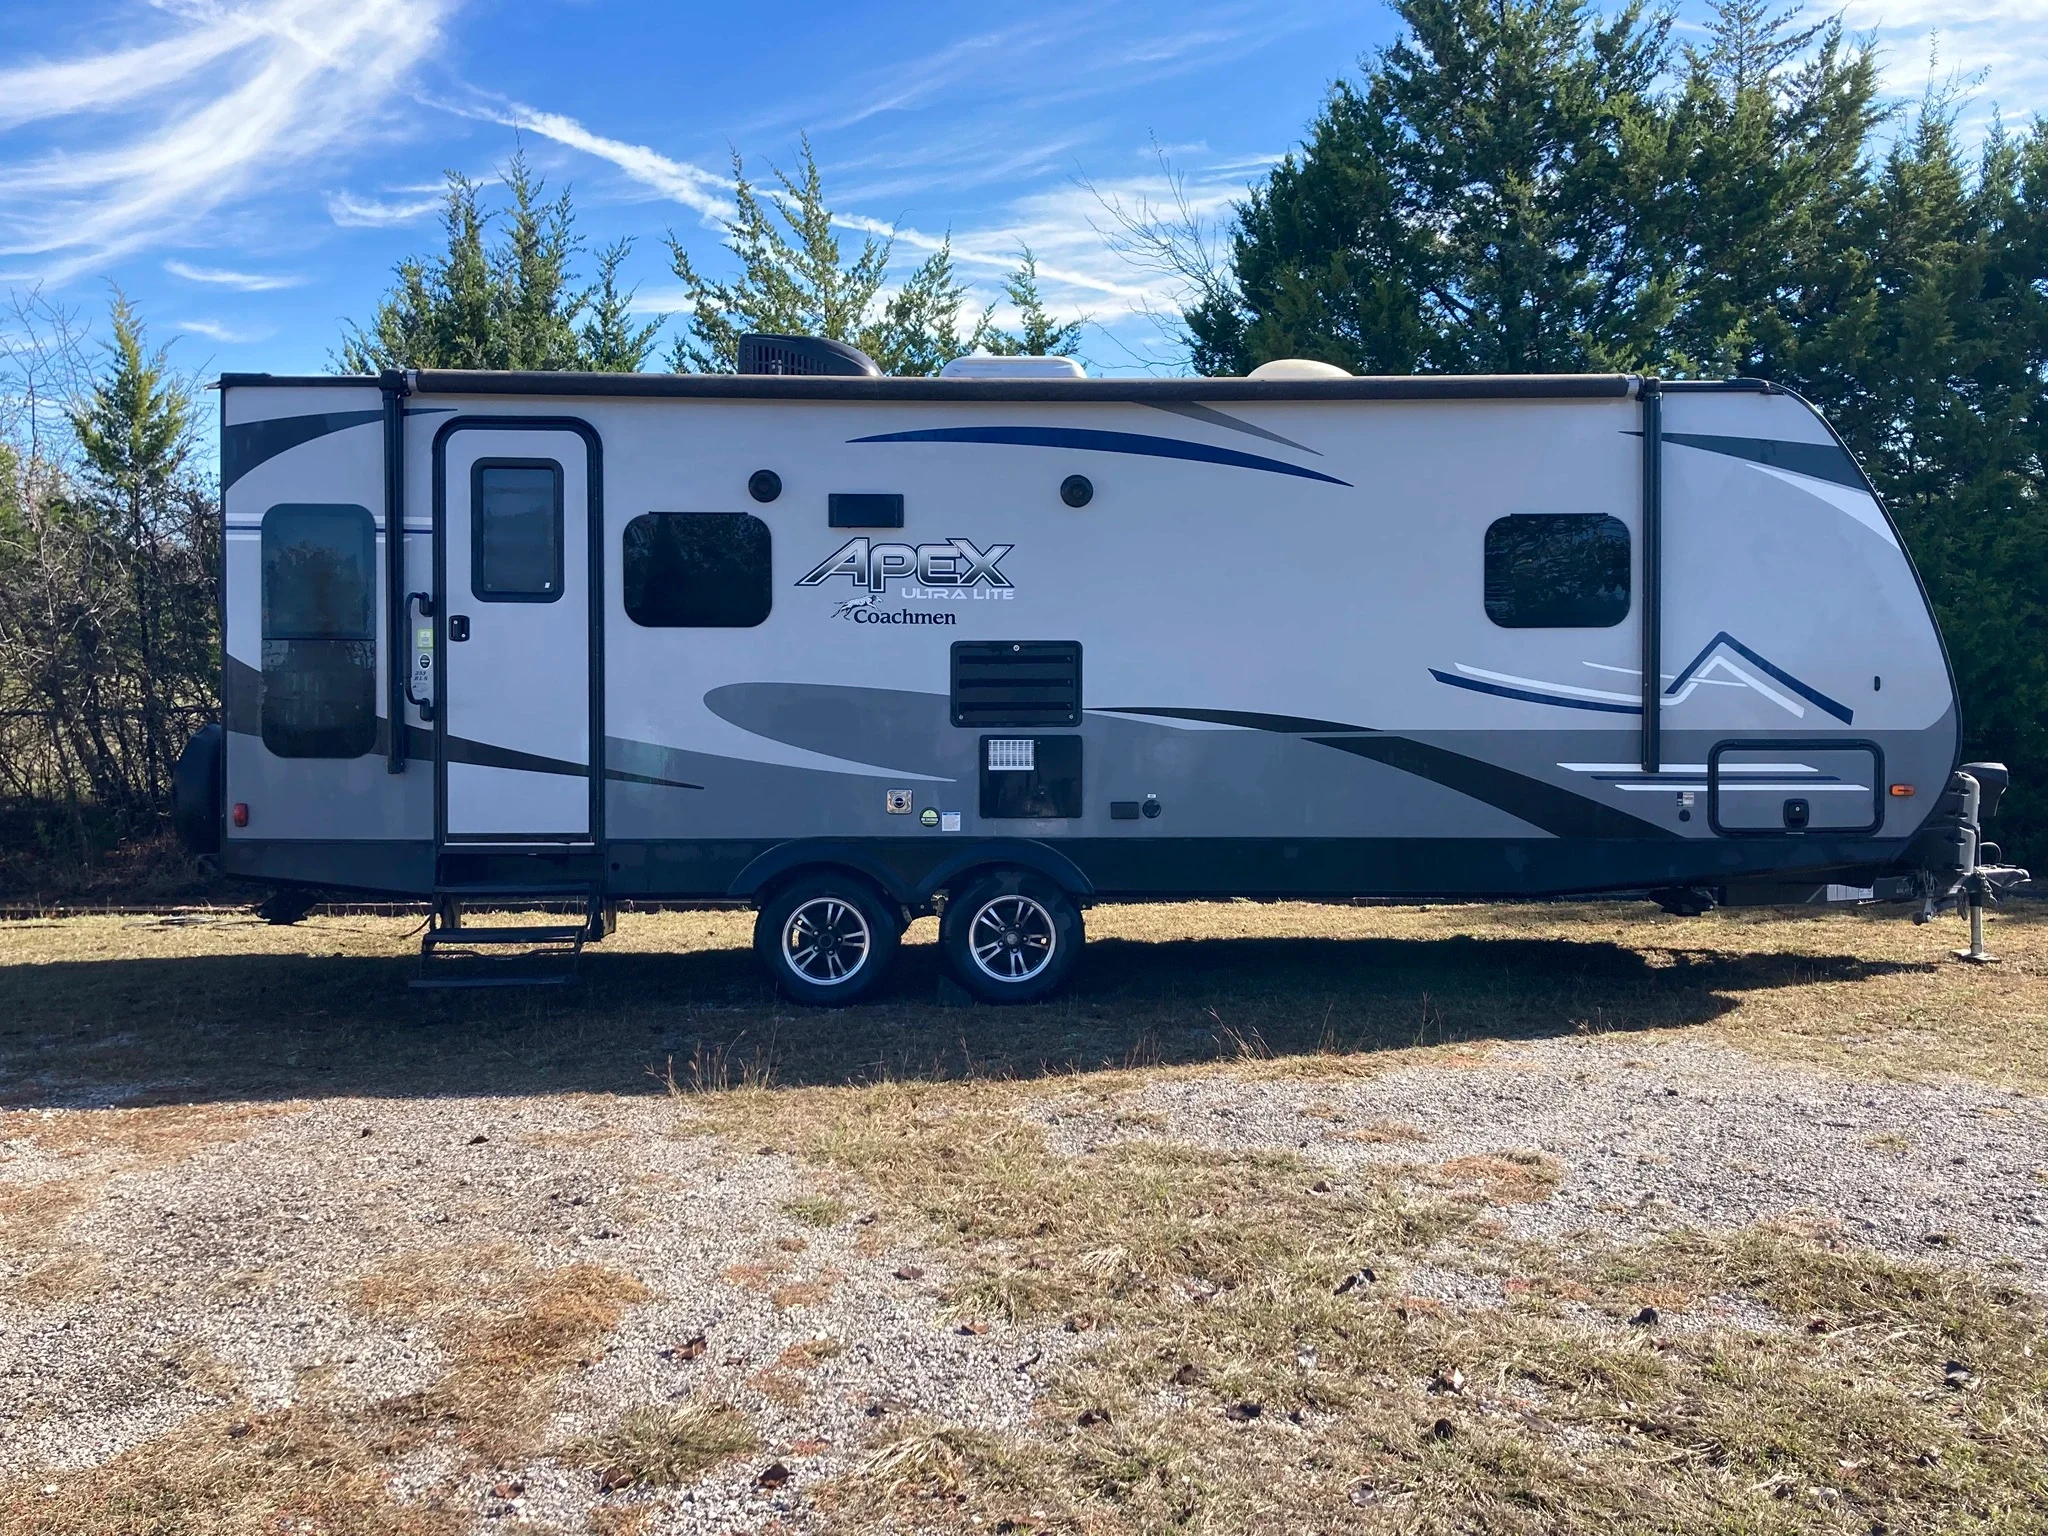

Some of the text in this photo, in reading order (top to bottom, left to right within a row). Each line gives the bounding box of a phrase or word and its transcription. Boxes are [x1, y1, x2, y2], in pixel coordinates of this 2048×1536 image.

[794, 537, 1015, 593] APEX
[901, 588, 1015, 600] ULTRA LITE
[853, 608, 956, 625] Coachmen
